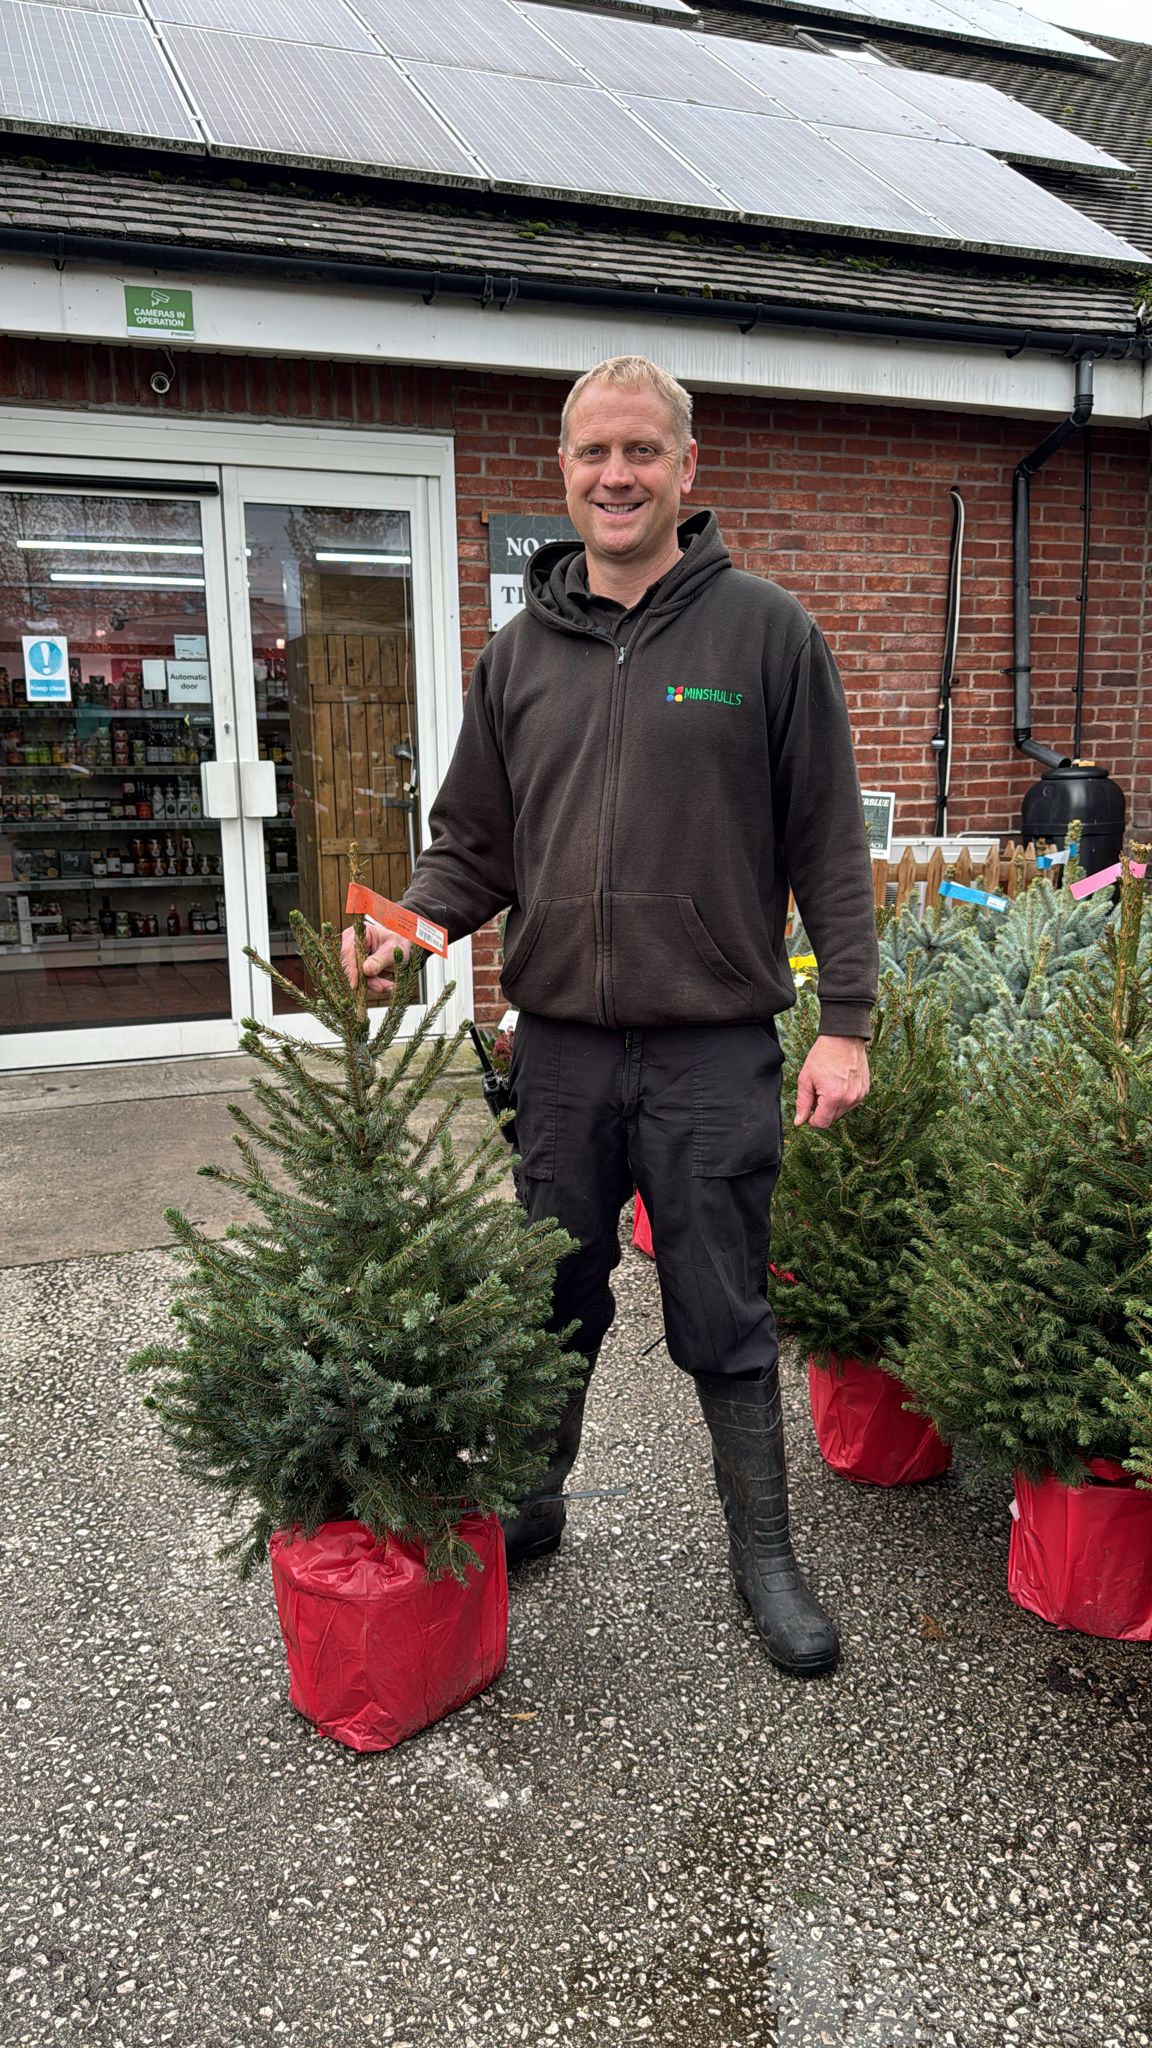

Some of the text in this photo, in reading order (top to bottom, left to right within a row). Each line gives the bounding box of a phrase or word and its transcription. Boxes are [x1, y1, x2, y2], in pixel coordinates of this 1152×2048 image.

[134, 308, 185, 319] CAMERAS IN
[136, 316, 184, 327] OPERATION
[506, 537, 540, 557] NO
[170, 673, 207, 681] Automatic
[30, 684, 66, 693] Keep clear
[180, 682, 198, 690] door
[684, 687, 743, 706] MINSHULL'S
